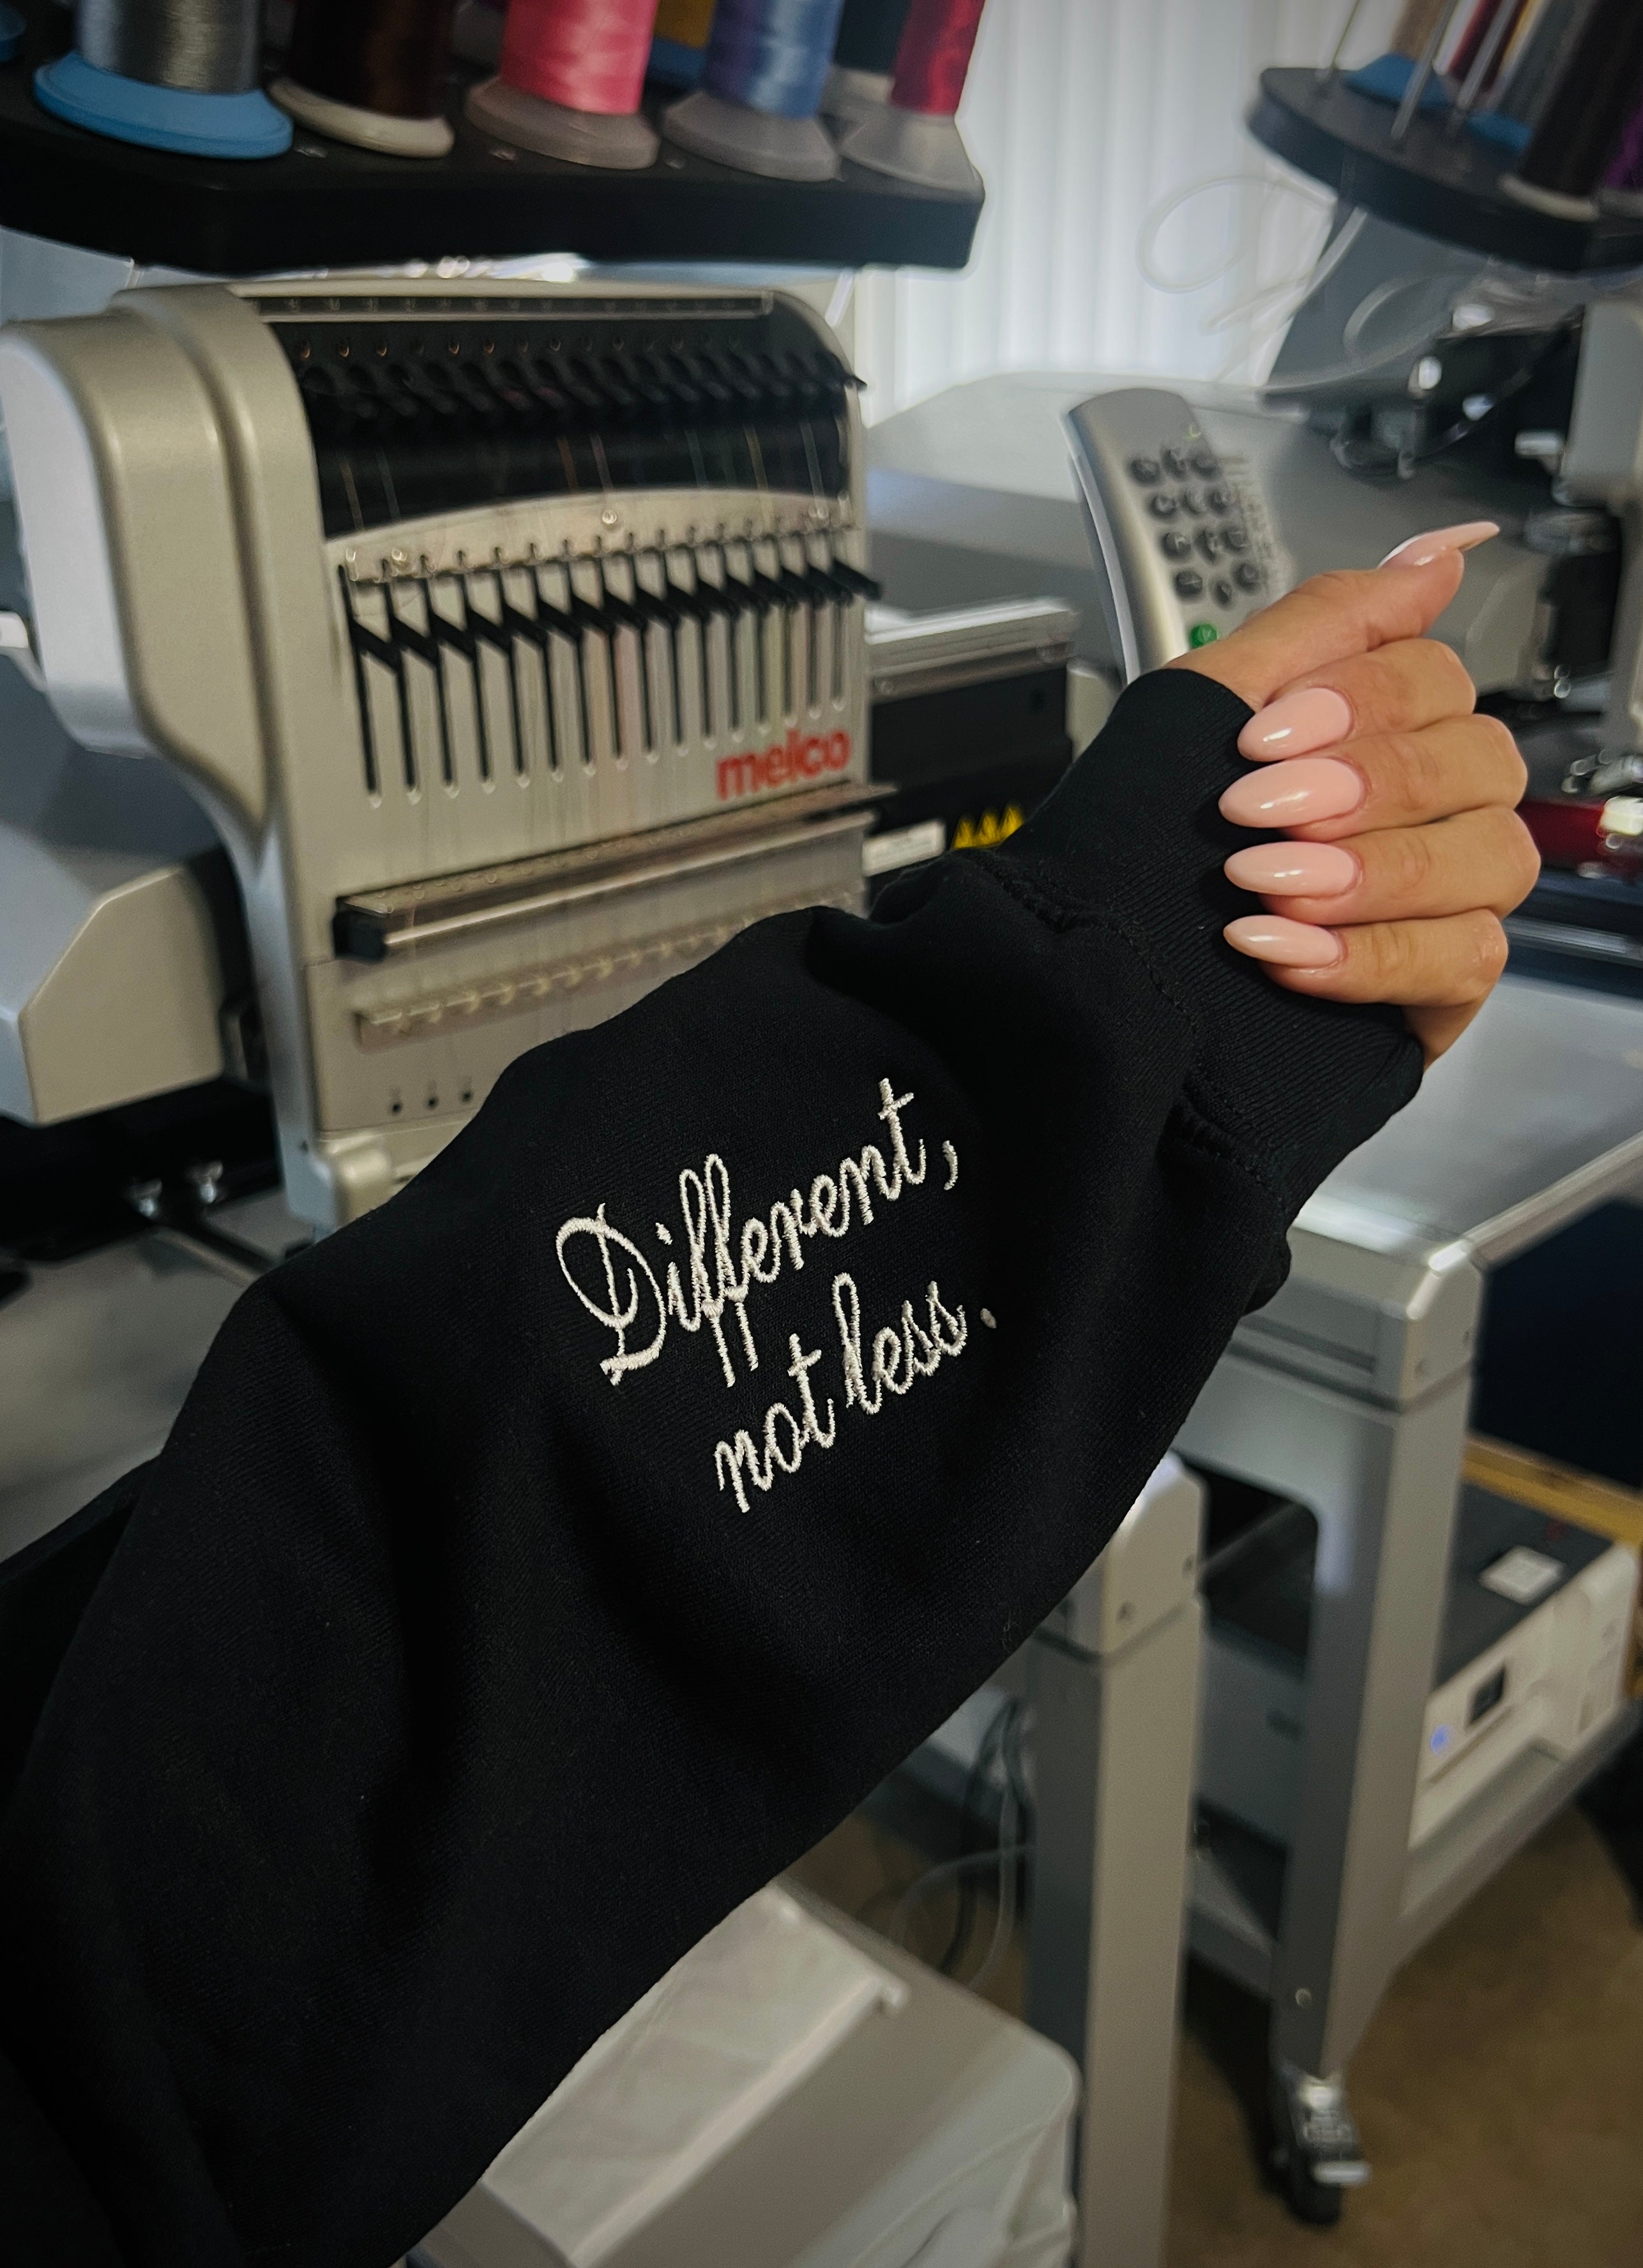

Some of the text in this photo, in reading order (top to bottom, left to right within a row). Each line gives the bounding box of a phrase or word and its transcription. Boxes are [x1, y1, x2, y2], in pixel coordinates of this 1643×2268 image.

[716, 727, 851, 801] melco
[555, 1077, 958, 1388] Different,
[713, 1272, 997, 1513] not less.
